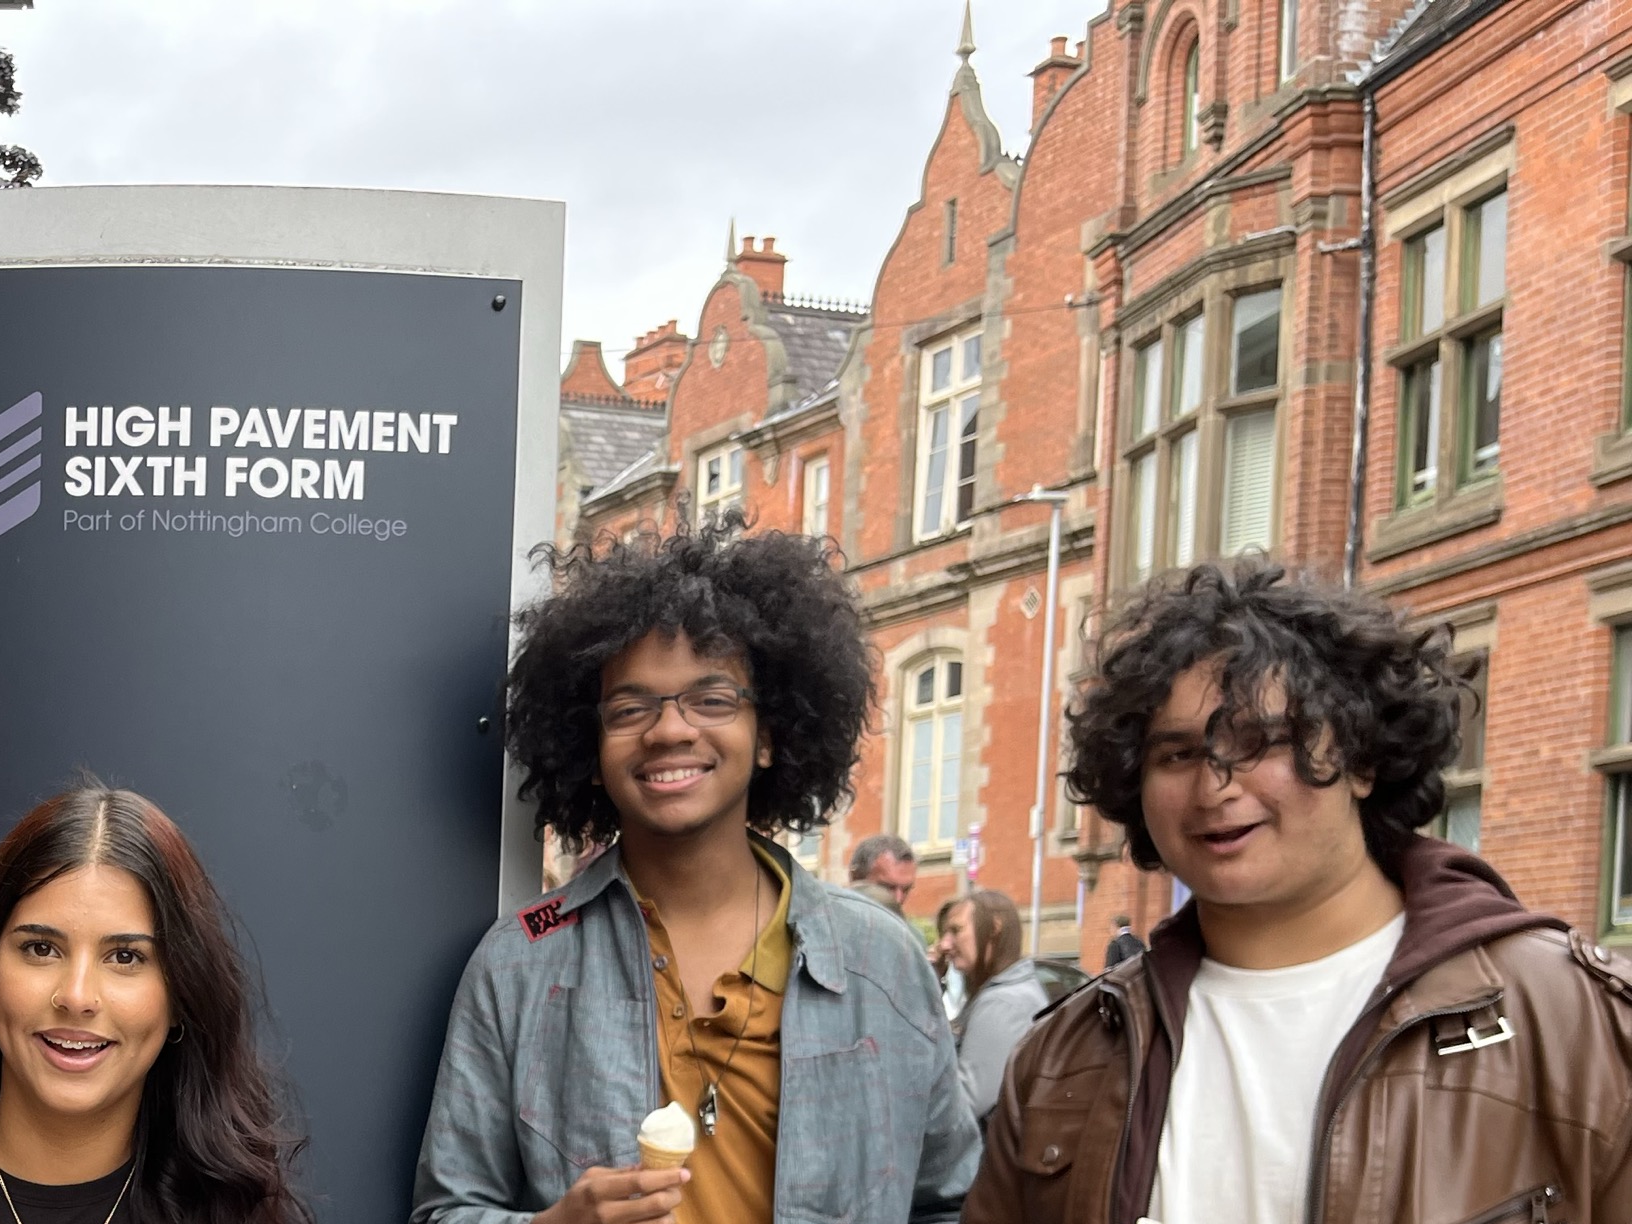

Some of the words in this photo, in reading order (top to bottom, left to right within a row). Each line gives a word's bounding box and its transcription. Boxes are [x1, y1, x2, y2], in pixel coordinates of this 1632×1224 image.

[64, 406, 191, 448] HIGH
[209, 407, 458, 454] PAVEMENT
[64, 455, 207, 498] SIXTH
[224, 457, 365, 500] FORM
[63, 509, 114, 532] Part
[119, 509, 146, 532] of
[152, 509, 303, 537] Nottingham
[309, 511, 408, 542] College
